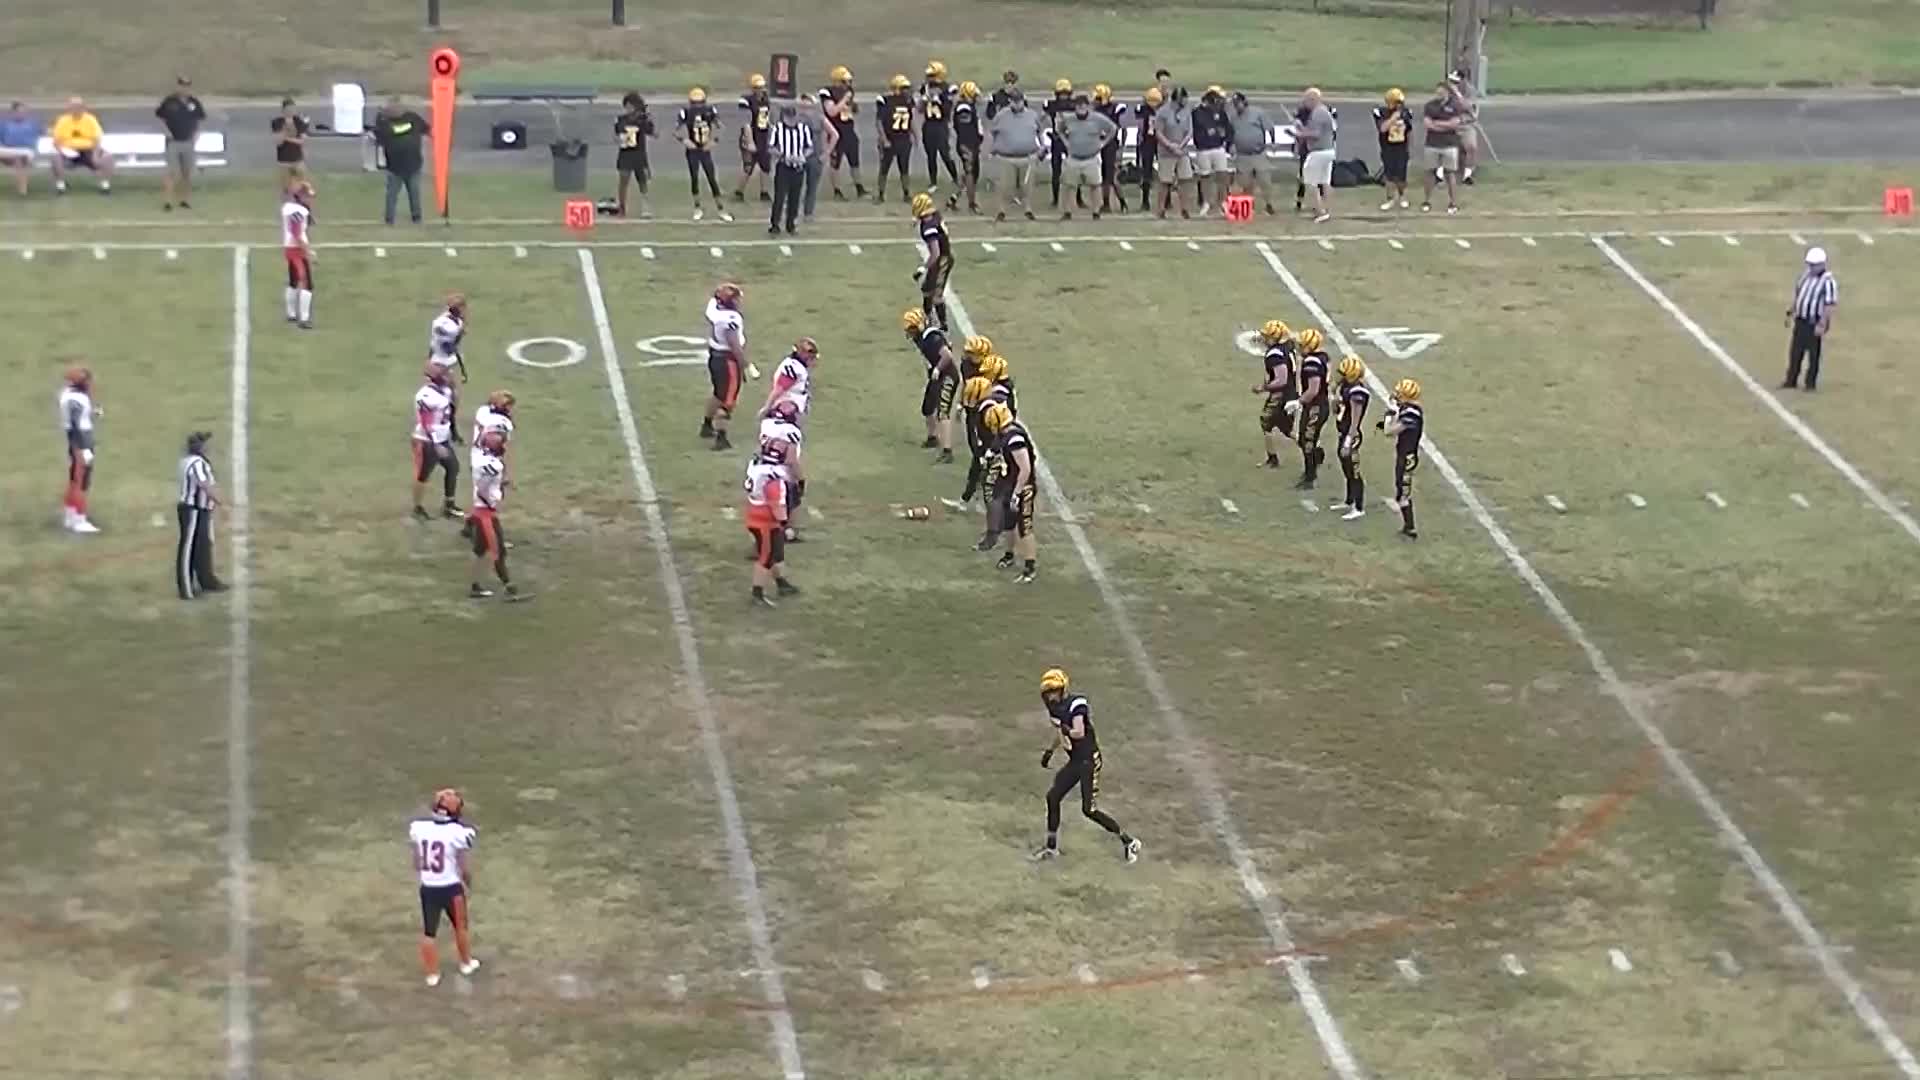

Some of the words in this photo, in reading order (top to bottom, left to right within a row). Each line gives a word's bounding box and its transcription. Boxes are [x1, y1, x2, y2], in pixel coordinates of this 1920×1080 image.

[569, 205, 591, 227] 50
[1228, 199, 1250, 221] 40
[420, 839, 445, 874] 13
